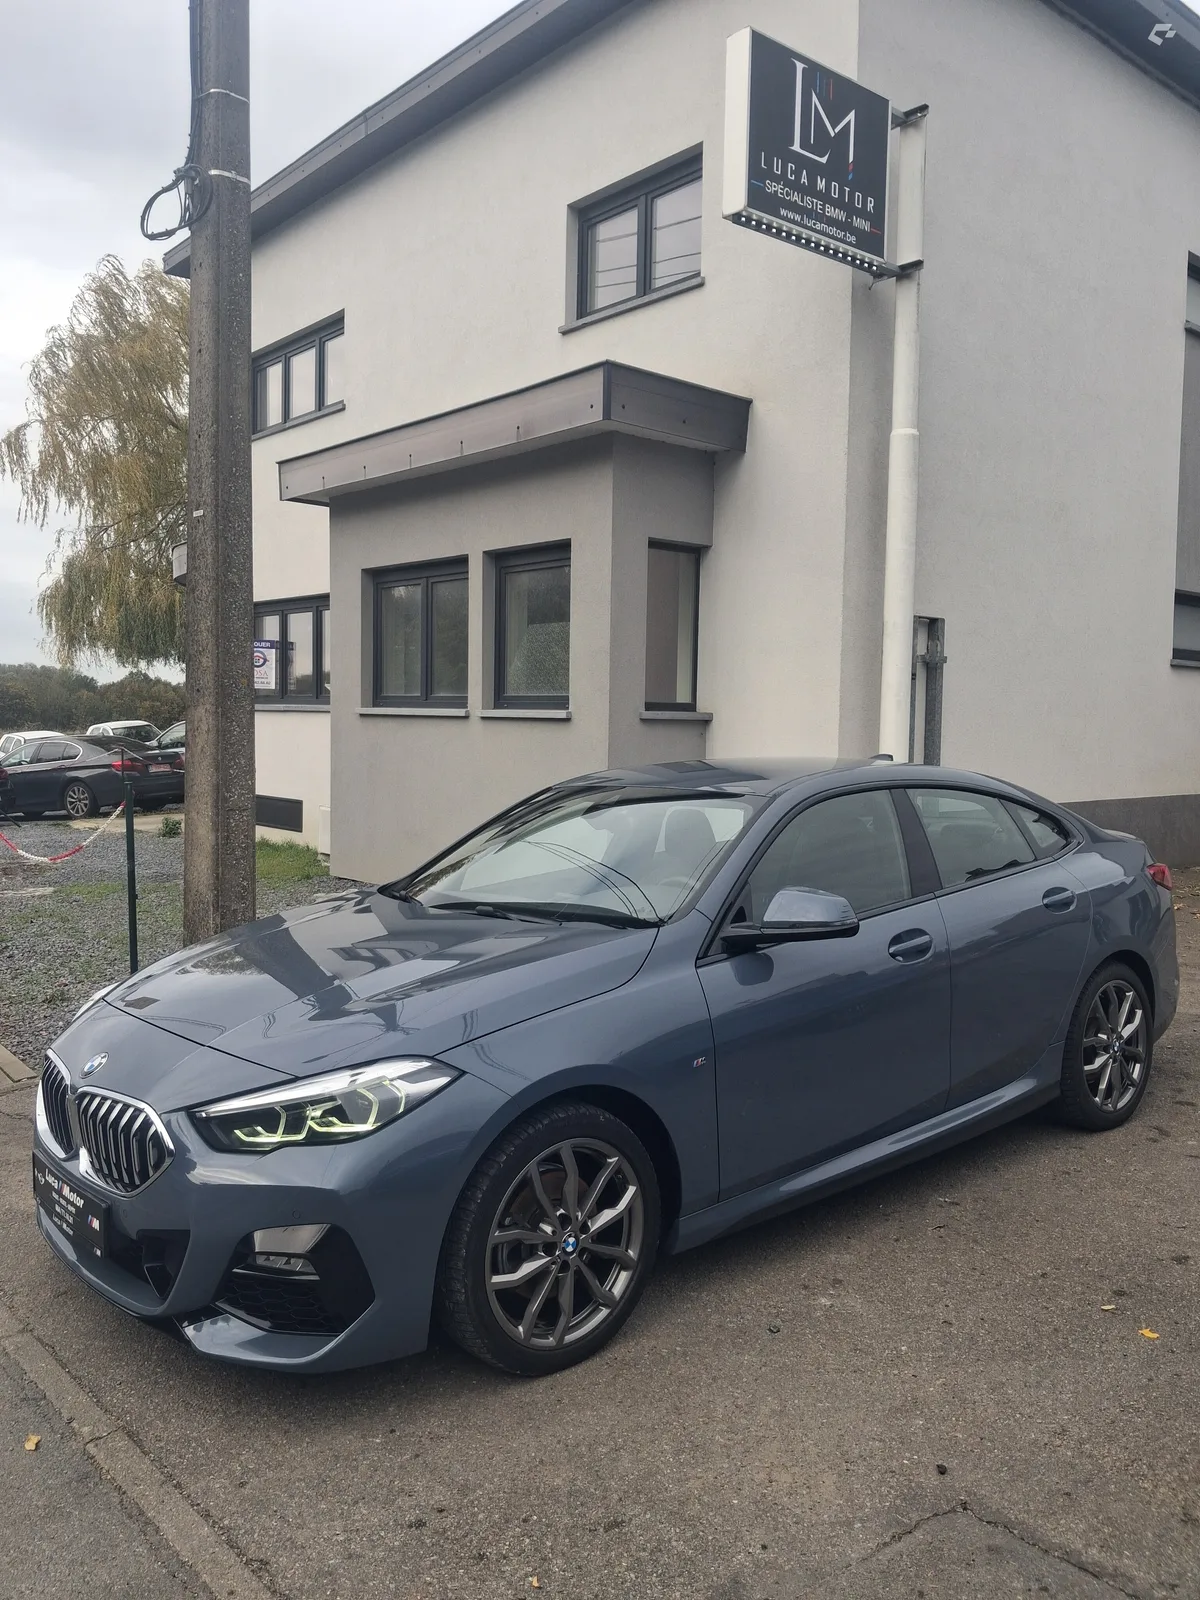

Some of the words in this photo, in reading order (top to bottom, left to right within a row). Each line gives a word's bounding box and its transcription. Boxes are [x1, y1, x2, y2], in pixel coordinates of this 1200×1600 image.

[761, 151, 808, 186] LUCA
[817, 177, 874, 214] MOTOR
[765, 179, 824, 214] SPÉCIALISTE
[825, 203, 847, 222] BMW
[853, 215, 871, 233] MINI
[779, 206, 857, 244] www.lucamotor.be
[45, 1168, 58, 1189] Luca
[62, 1185, 84, 1208] Motor
